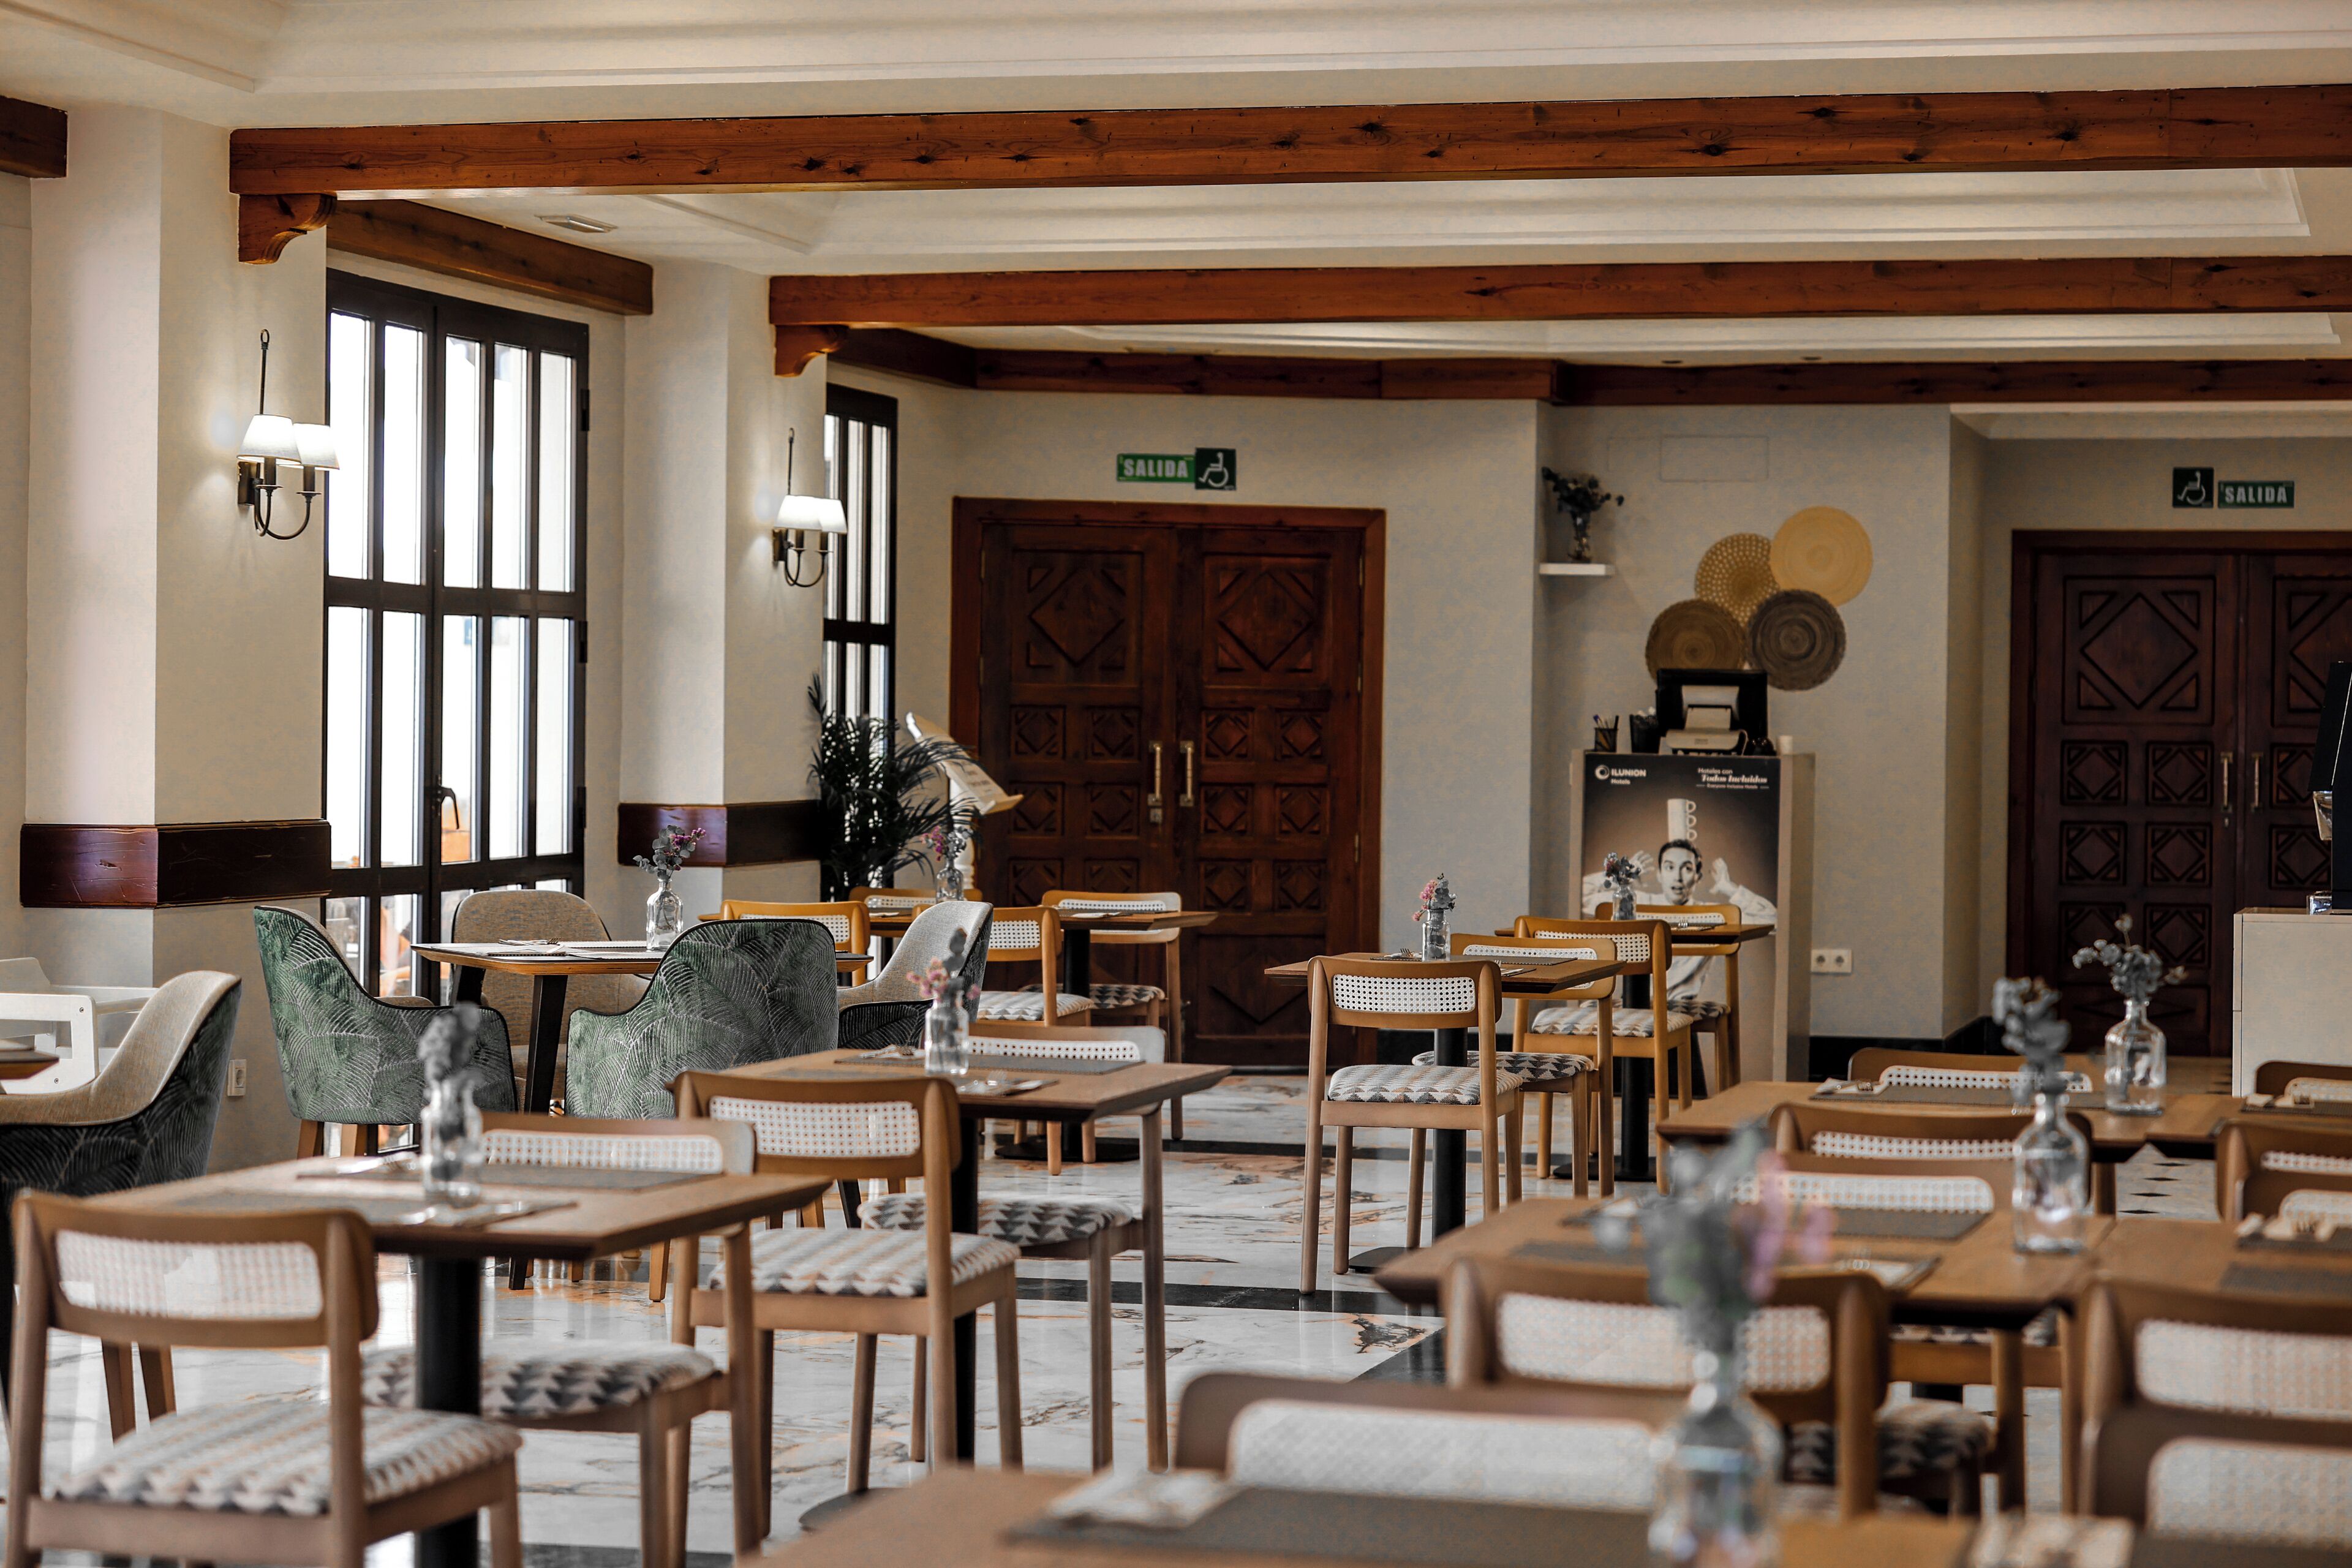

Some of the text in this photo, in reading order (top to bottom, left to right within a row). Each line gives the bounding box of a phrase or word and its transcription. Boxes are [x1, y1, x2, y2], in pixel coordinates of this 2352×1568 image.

[1123, 459, 1188, 478] SALIDA
[2225, 486, 2287, 503] SALIDA
[1611, 769, 1646, 777] ILUNION
